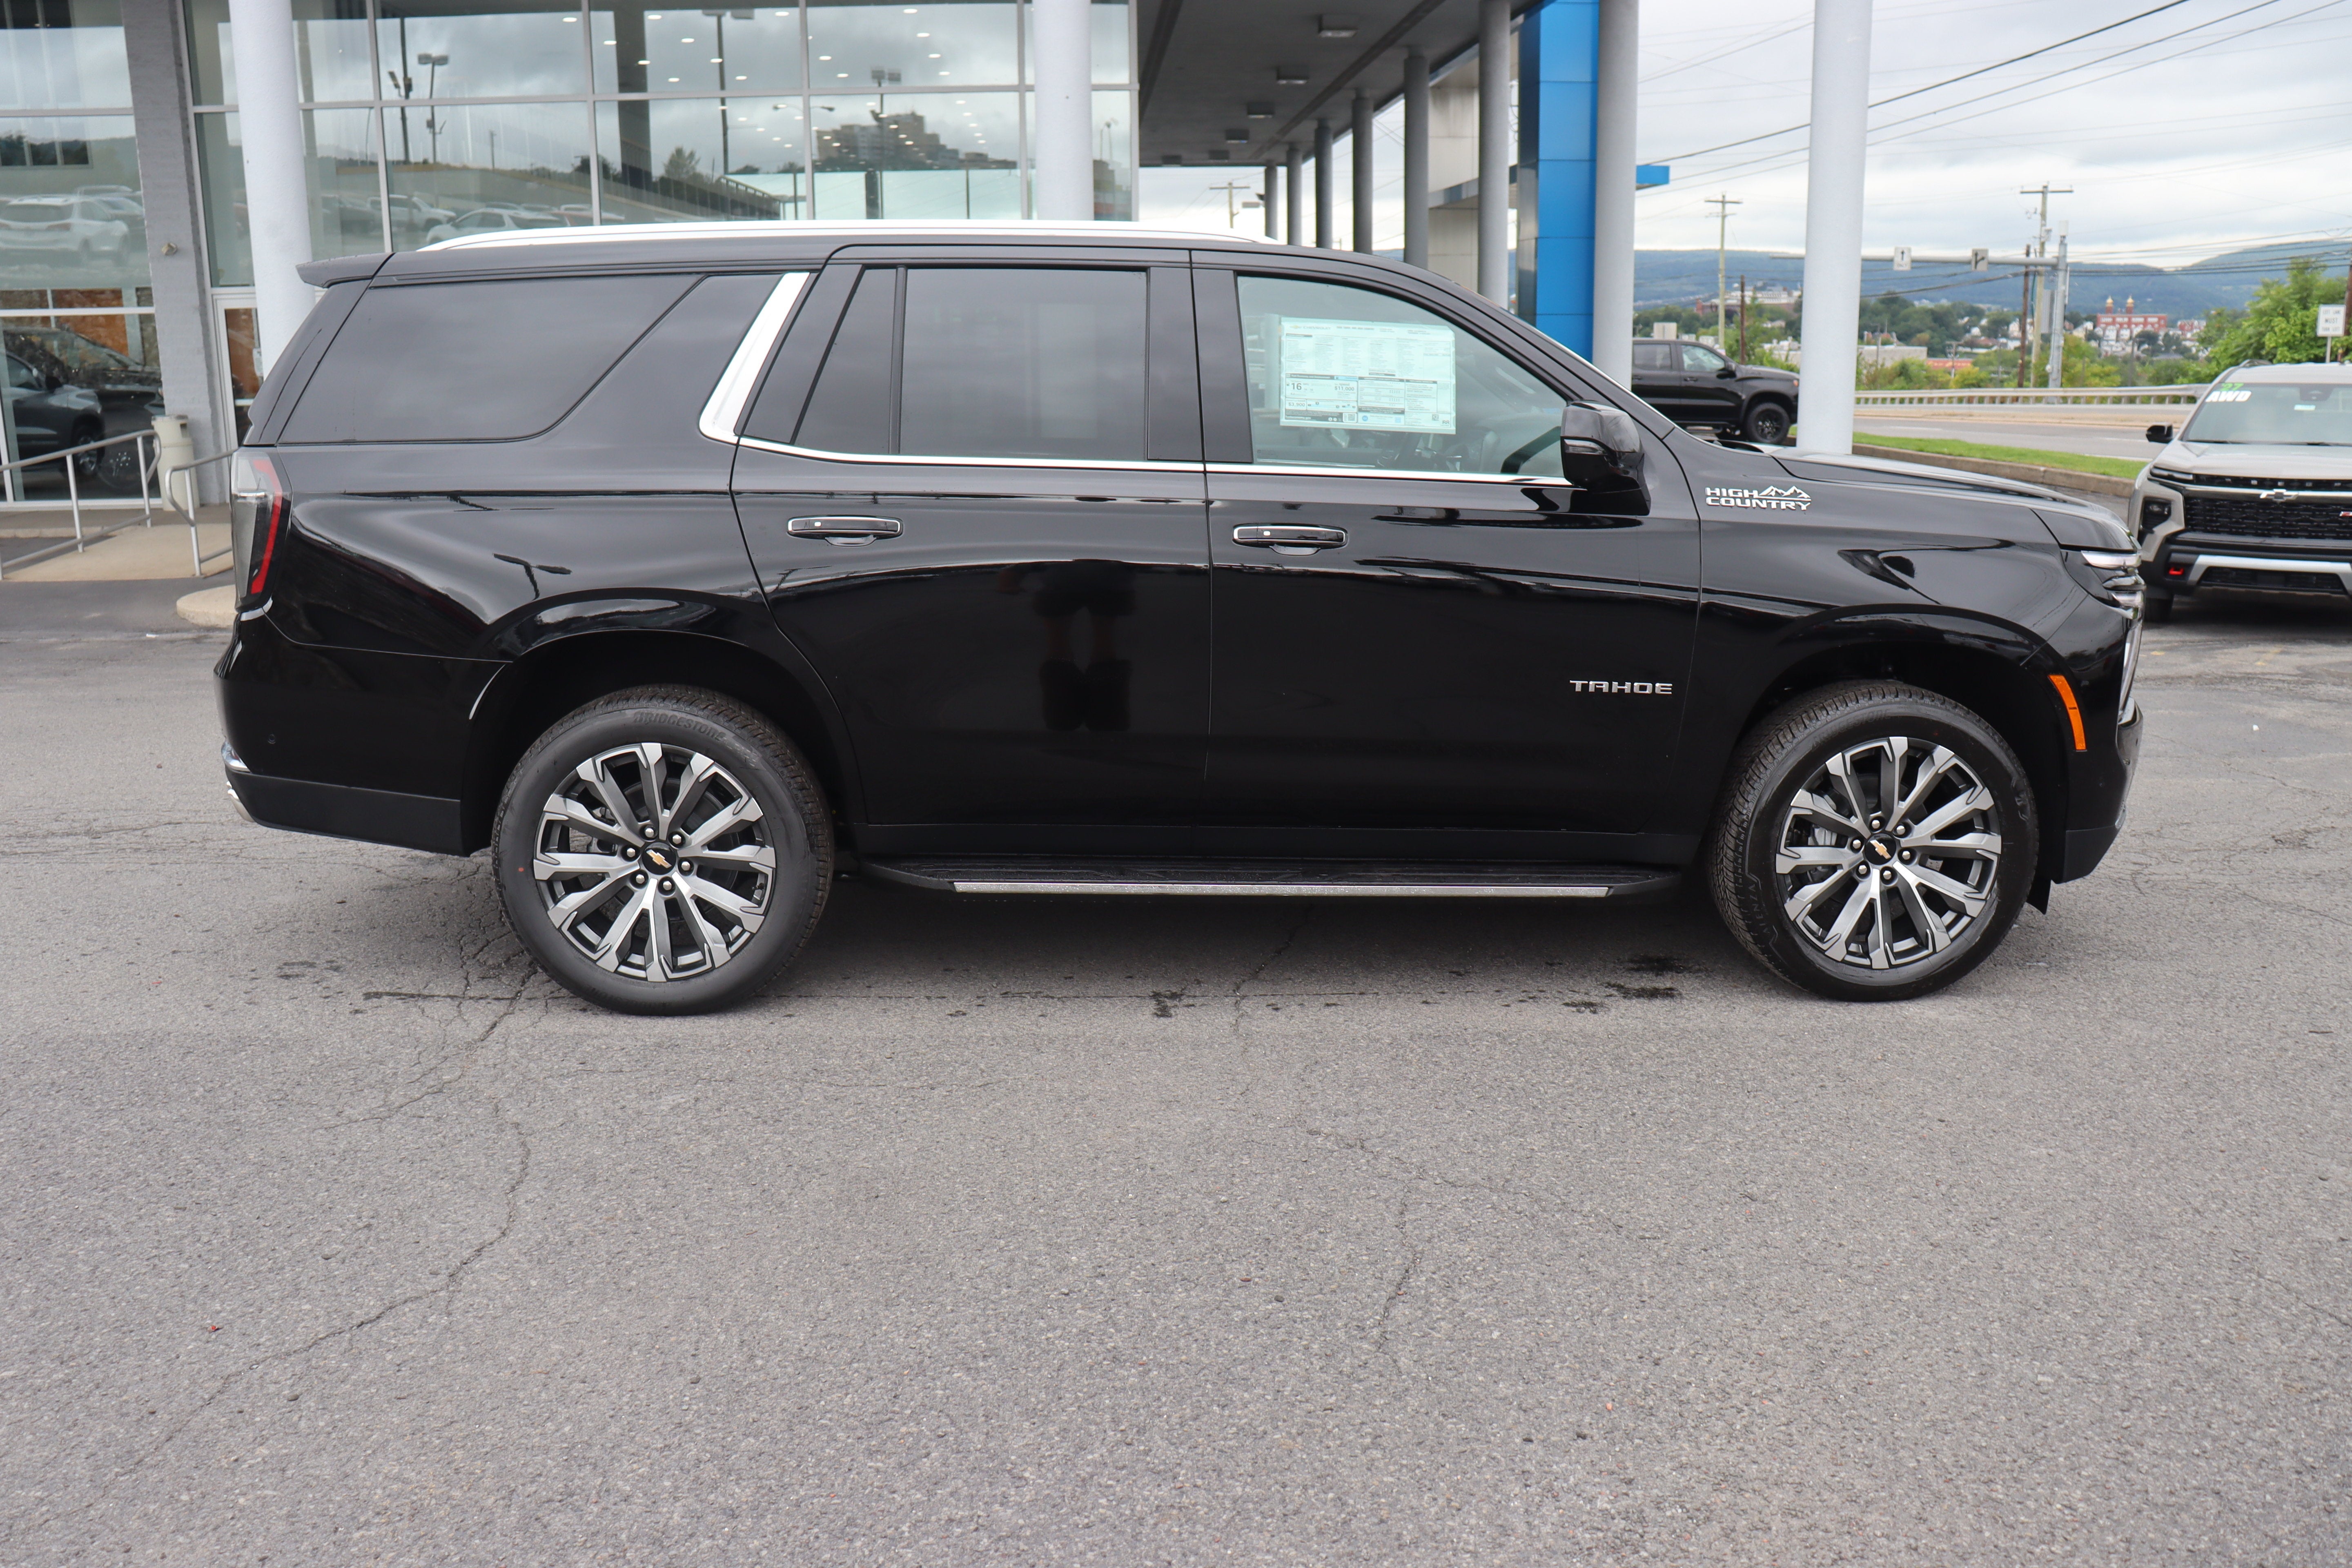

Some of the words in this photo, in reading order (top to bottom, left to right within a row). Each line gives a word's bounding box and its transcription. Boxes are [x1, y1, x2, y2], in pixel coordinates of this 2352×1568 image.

[2205, 390, 2252, 402] AWD
[1705, 487, 1758, 498] HIGH
[1706, 497, 1811, 511] COUNTRY
[1569, 680, 1673, 694] TAHOE
[633, 712, 726, 741] BRIDGESTONE
